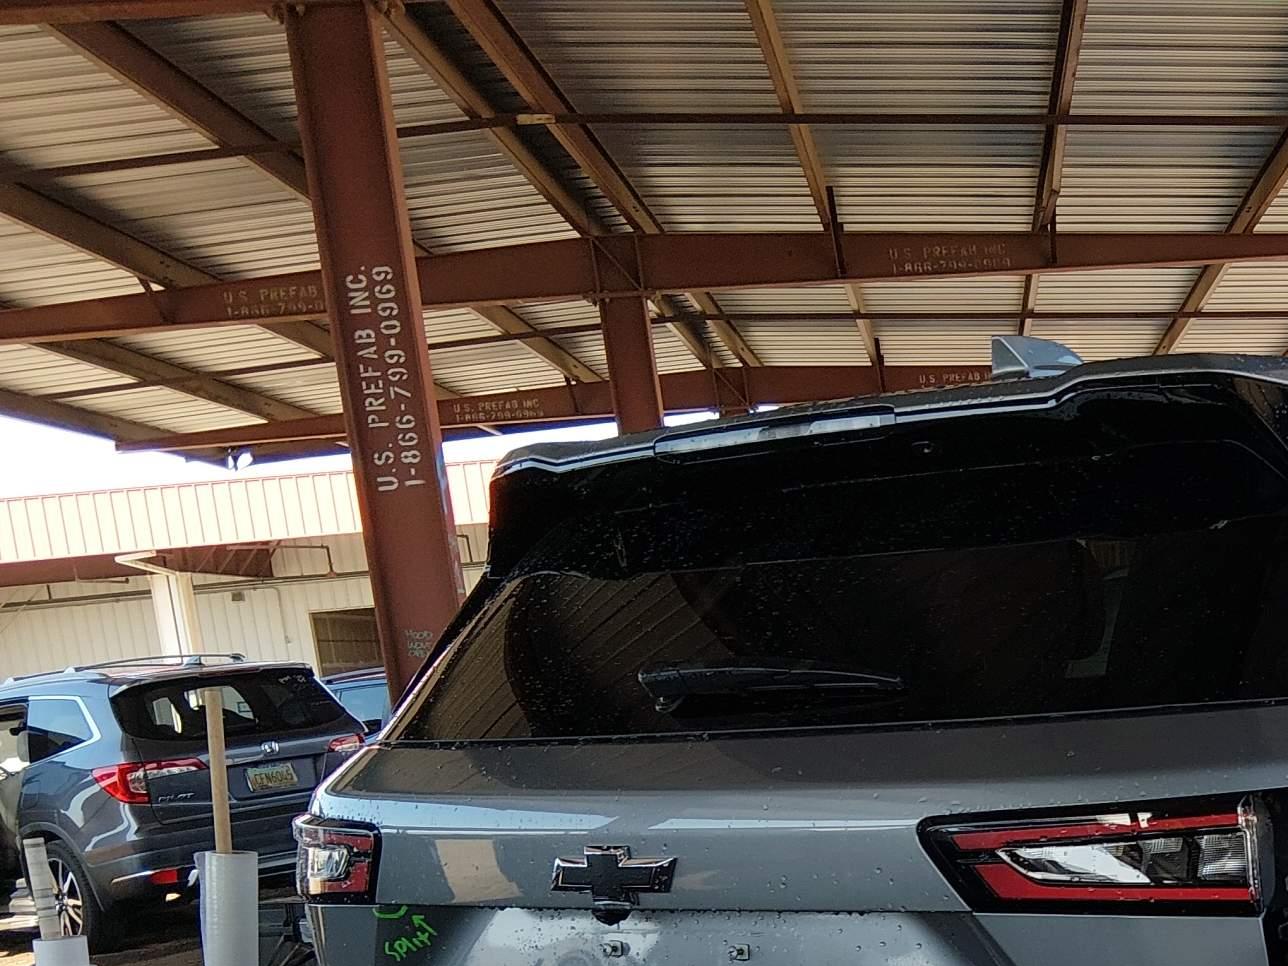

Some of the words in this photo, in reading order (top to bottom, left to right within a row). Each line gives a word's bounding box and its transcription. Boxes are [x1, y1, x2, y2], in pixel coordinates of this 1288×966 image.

[259, 284, 319, 301] PREFAB
[345, 265, 372, 315] INC.
[354, 328, 390, 428] PREFAB
[371, 265, 427, 487] 1-866-799-0969
[477, 399, 519, 412] PREFAB
[373, 443, 400, 492] U.S.
